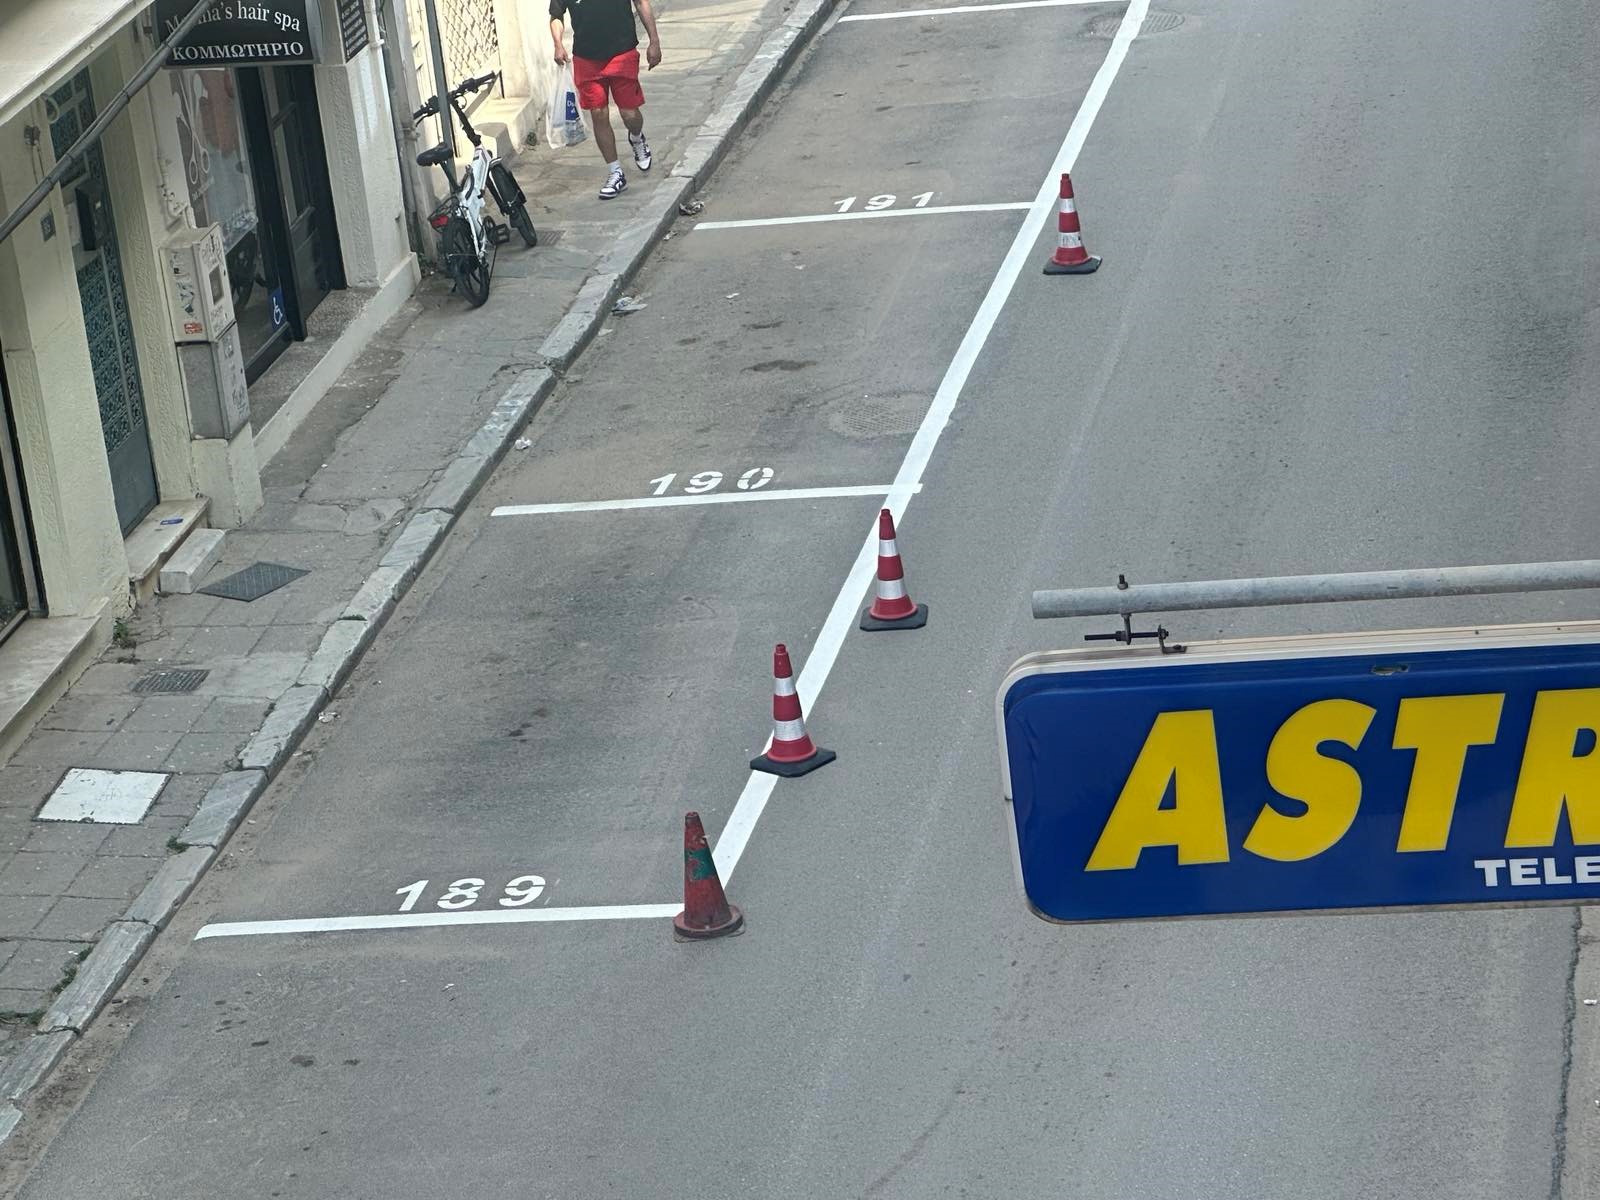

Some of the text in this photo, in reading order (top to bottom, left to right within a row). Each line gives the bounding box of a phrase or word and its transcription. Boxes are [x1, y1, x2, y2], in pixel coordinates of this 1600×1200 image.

[237, 1, 270, 21] hair
[274, 11, 300, 32] spa
[172, 42, 304, 60] ΚΟΜΜΩΤΗΡΙΟ
[834, 191, 934, 212] 191
[650, 467, 774, 495] 190
[1085, 688, 1600, 872] ASTR
[1474, 856, 1600, 887] TELE
[395, 875, 546, 911] 189
